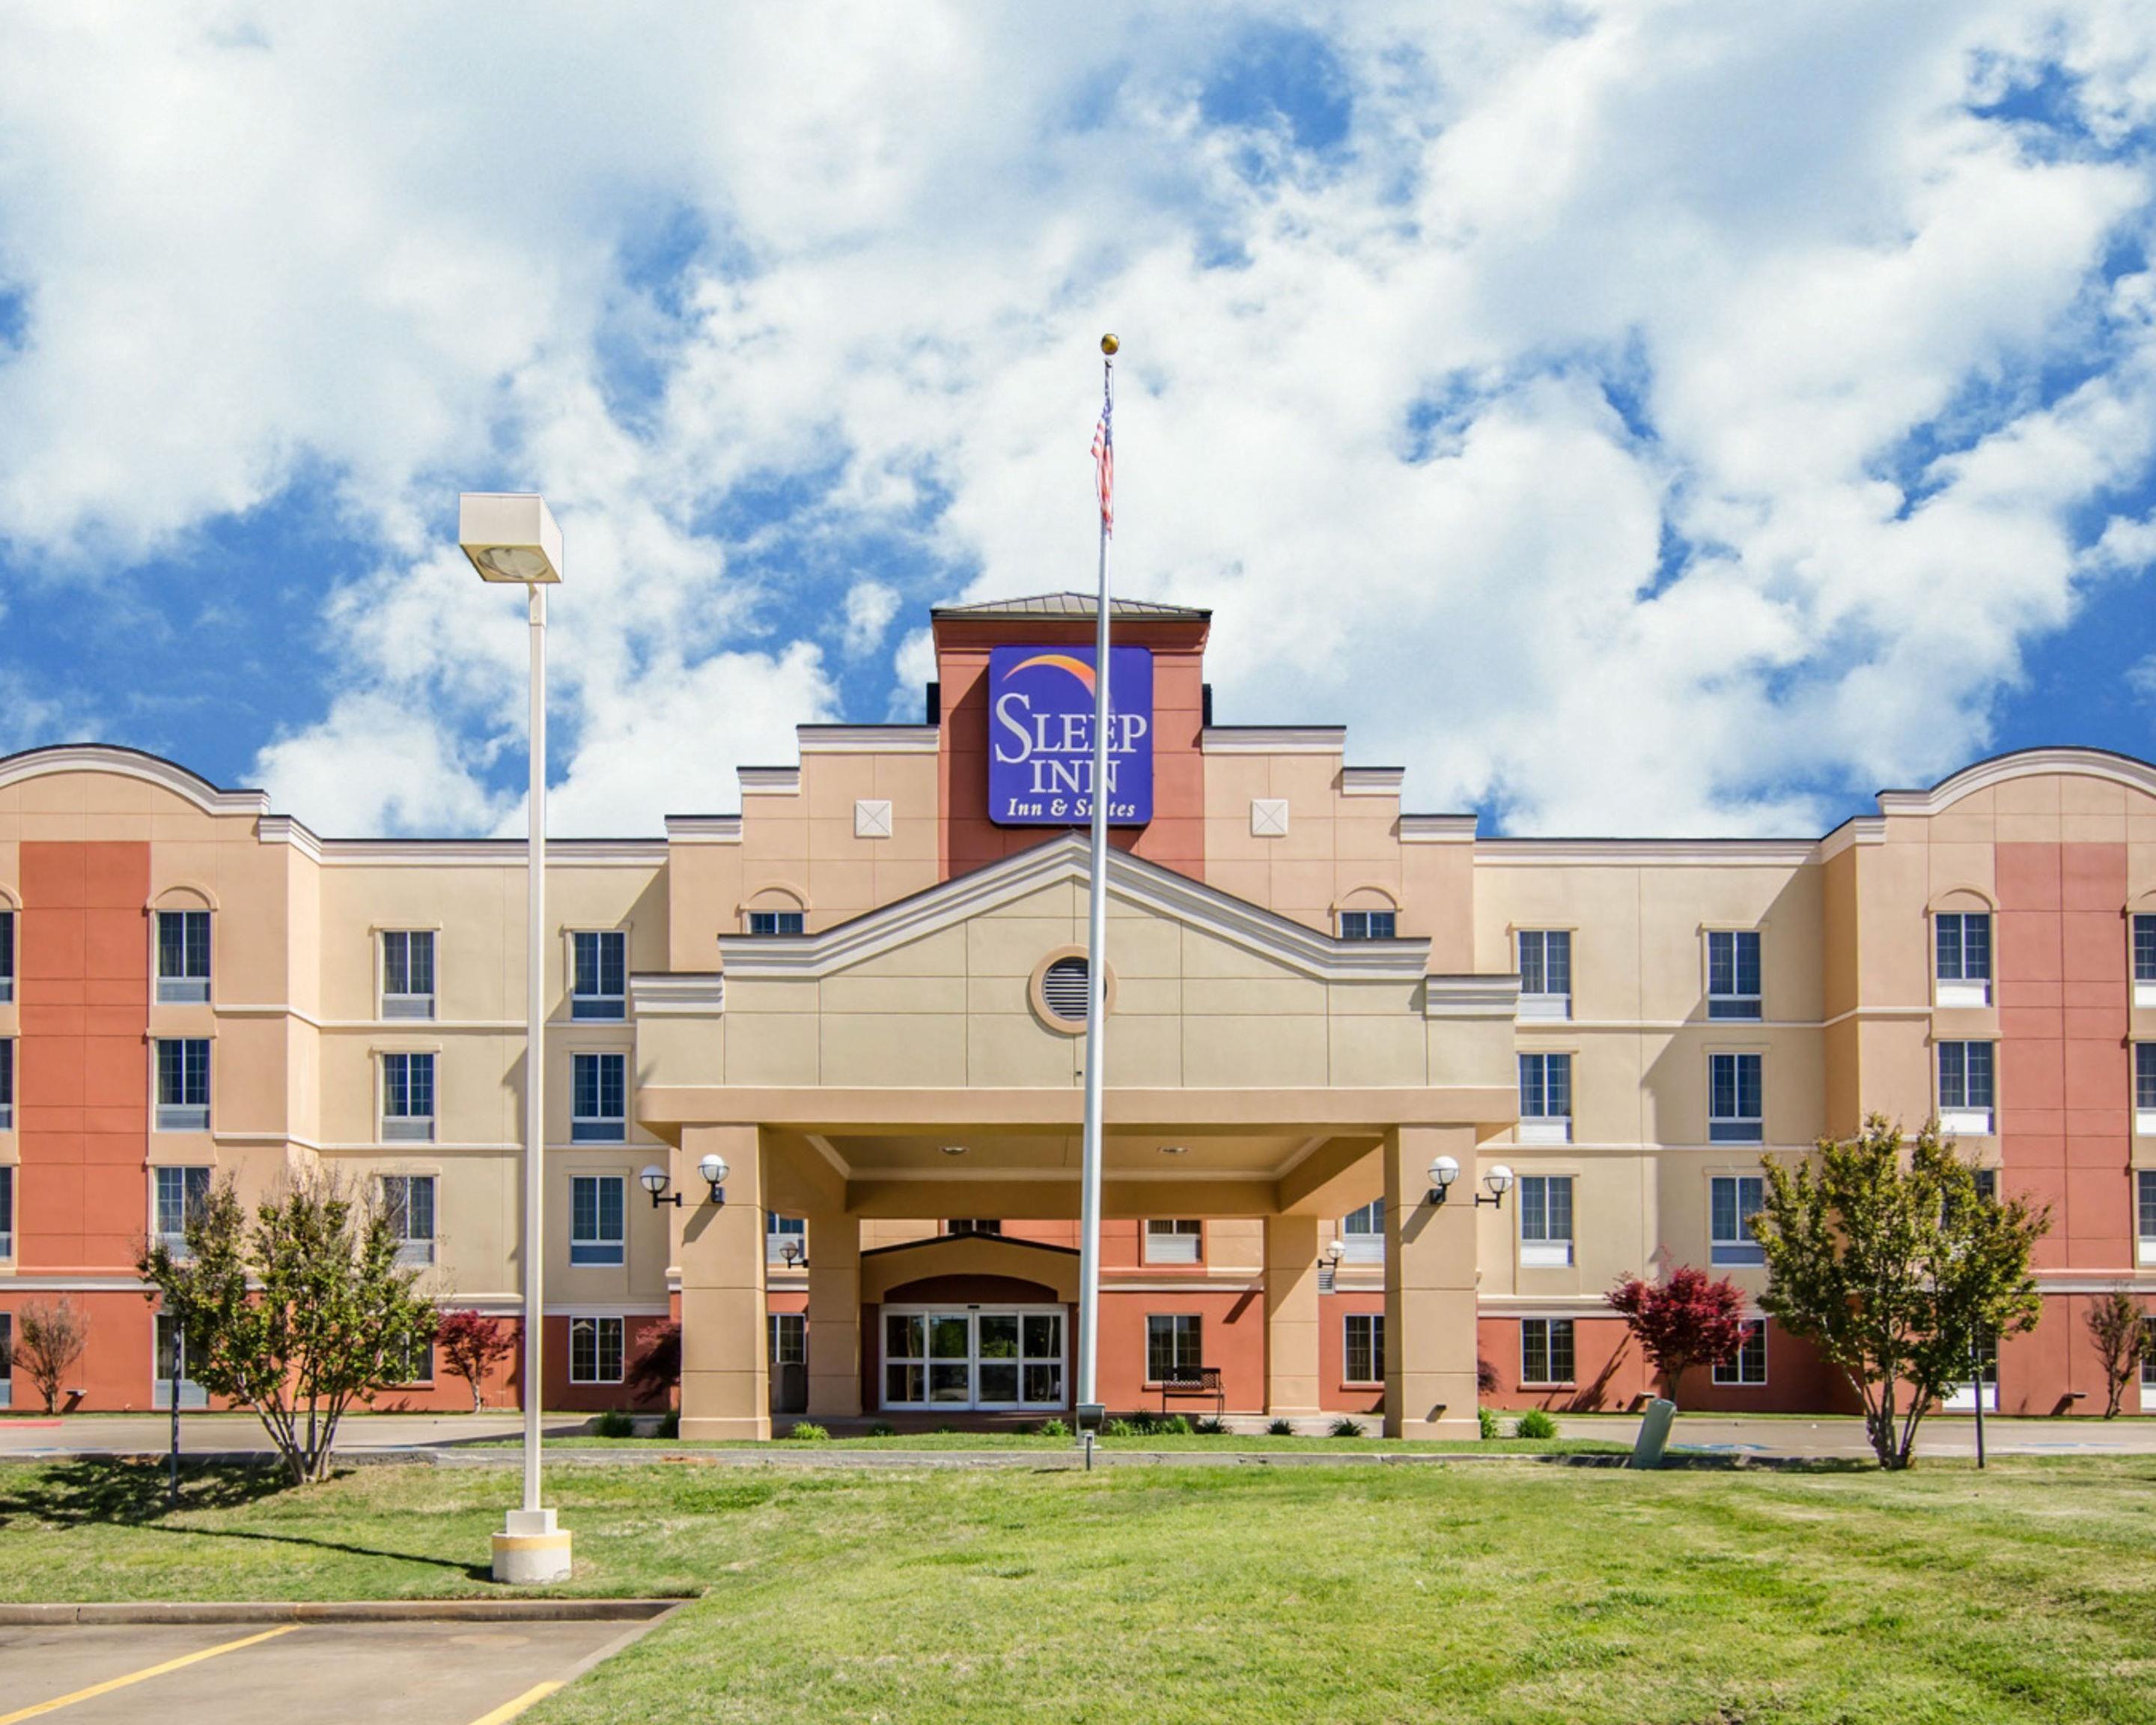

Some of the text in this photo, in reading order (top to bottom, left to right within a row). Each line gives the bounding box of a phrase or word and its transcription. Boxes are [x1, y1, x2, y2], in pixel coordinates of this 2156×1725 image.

[1029, 759, 1121, 794] INN
[1008, 797, 1136, 817] Inn & Stes
